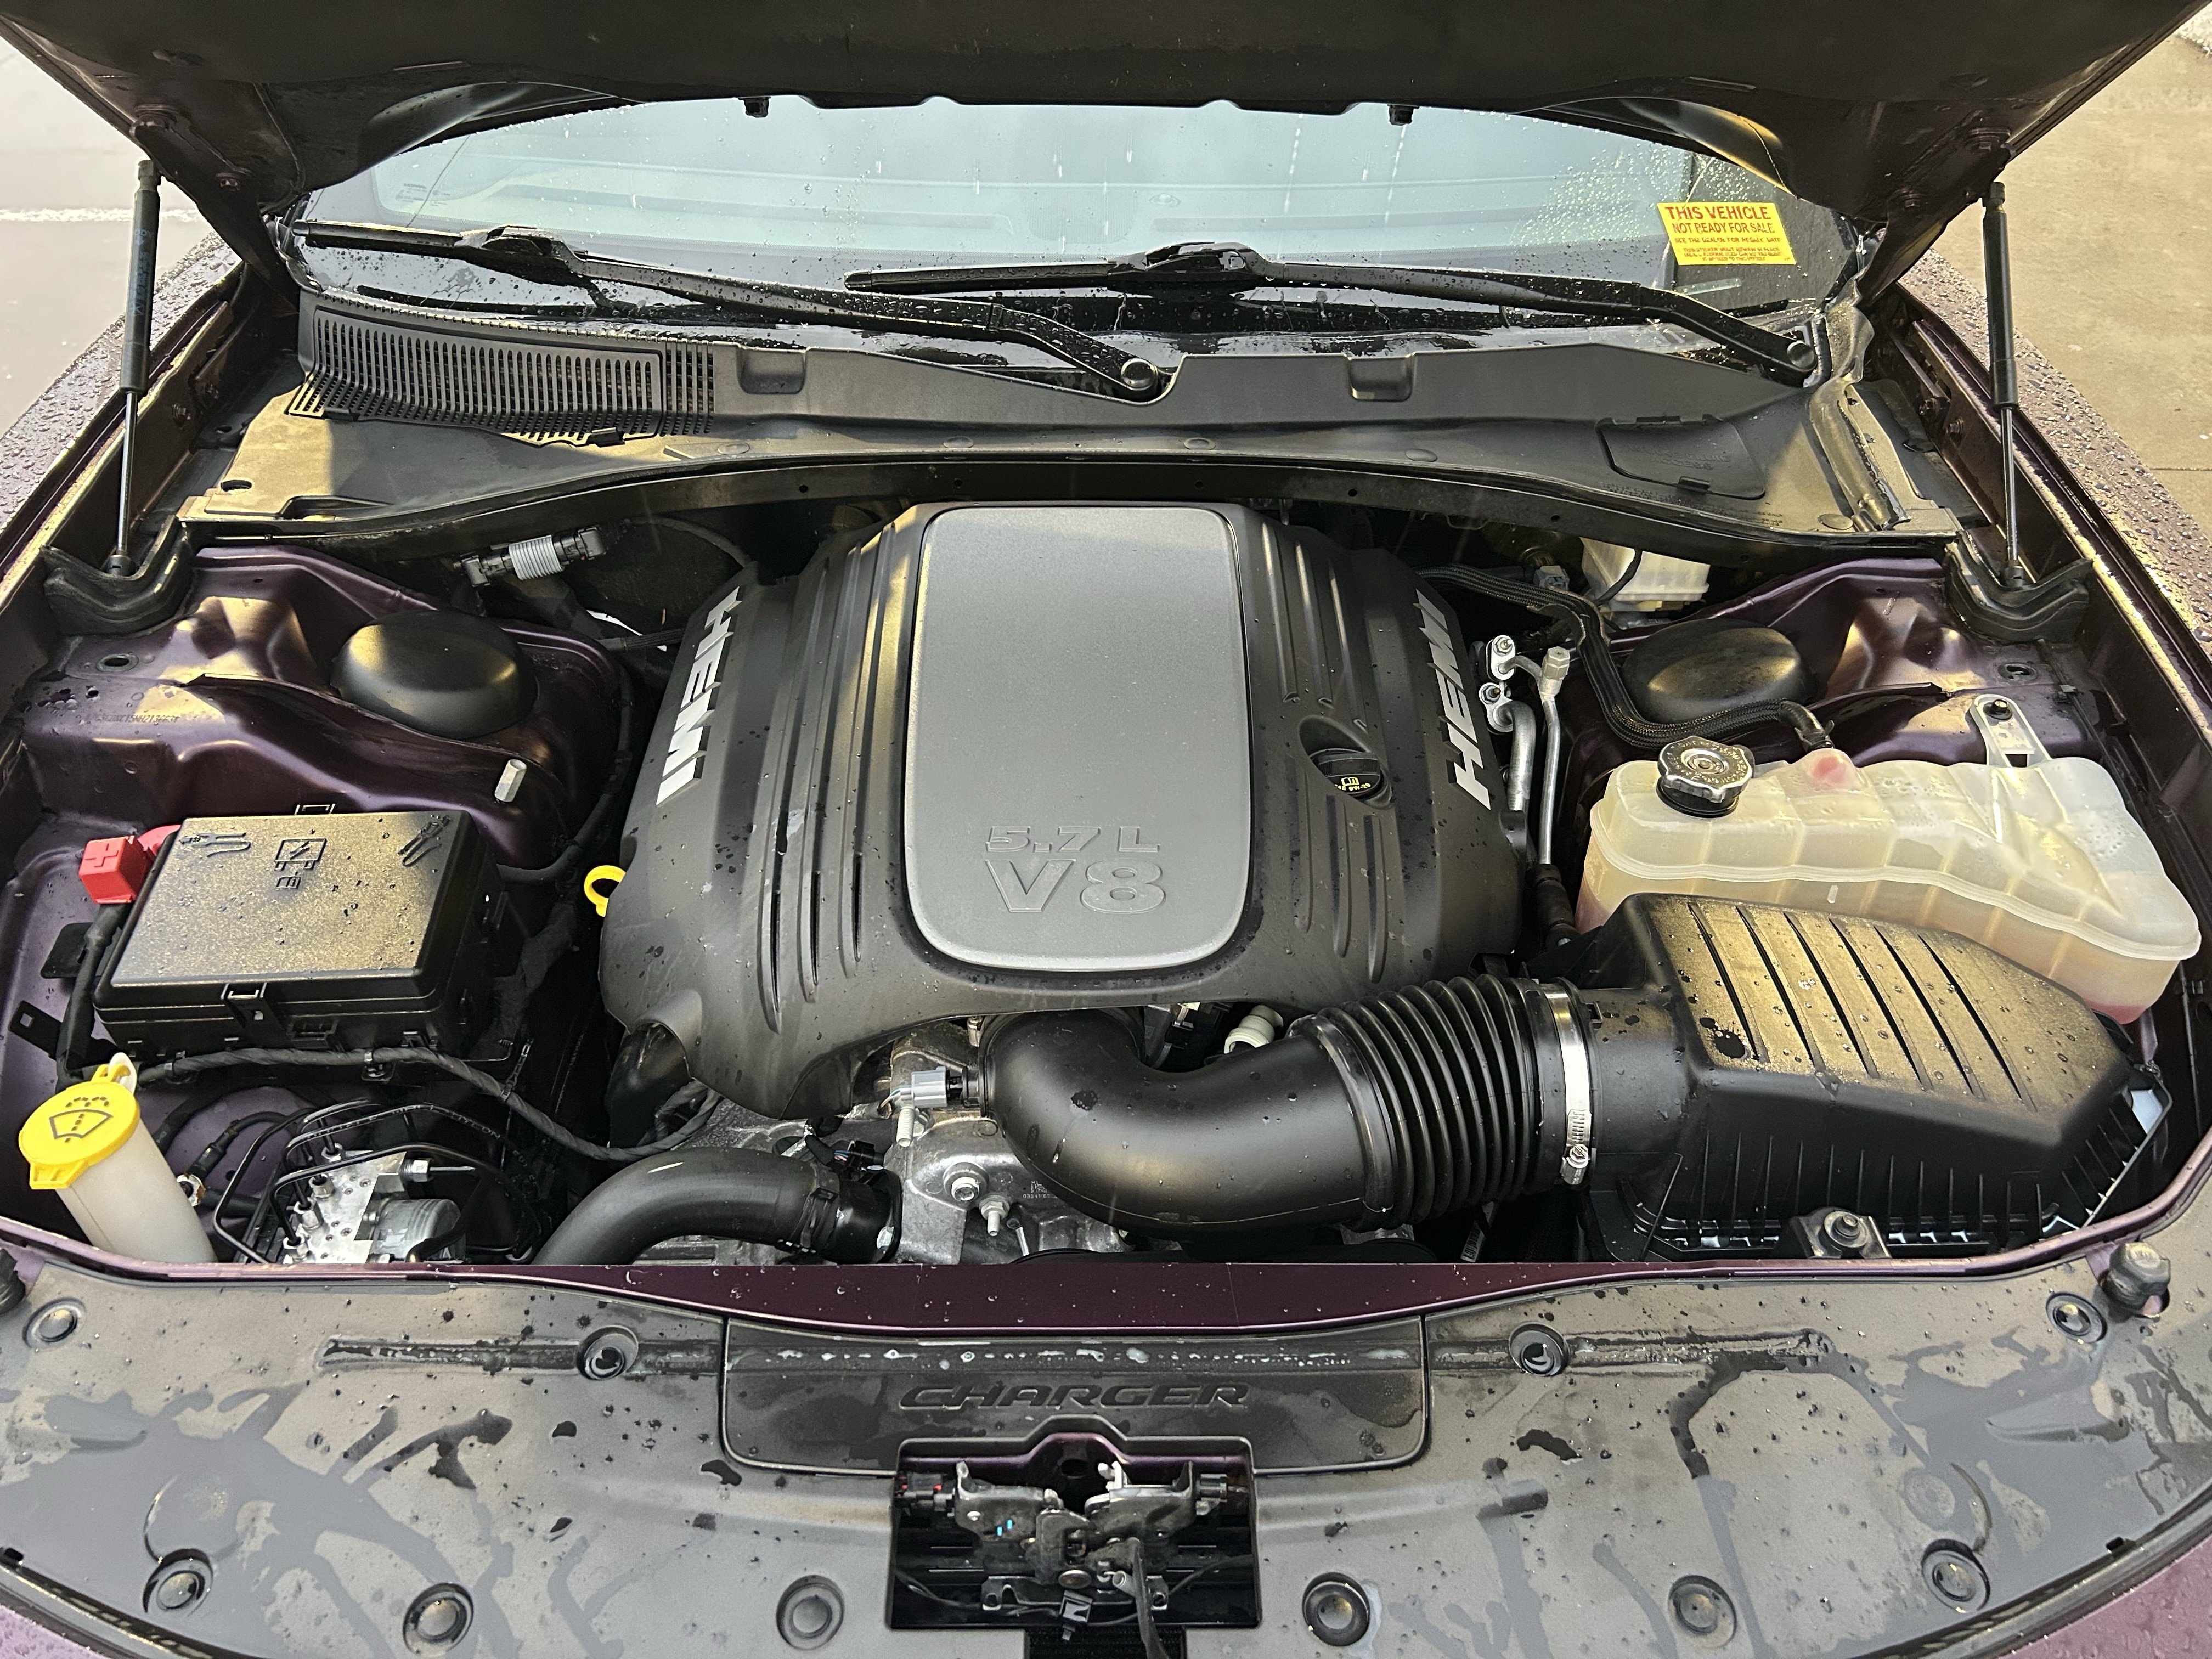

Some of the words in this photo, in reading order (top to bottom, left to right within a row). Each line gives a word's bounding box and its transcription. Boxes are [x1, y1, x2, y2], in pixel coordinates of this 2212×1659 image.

[1665, 206, 1703, 220] THIS
[1705, 206, 1771, 219] VEHICLE
[1672, 223, 1692, 233] NOT
[1695, 223, 1726, 233] READY
[1729, 223, 1750, 233] FOR
[1751, 223, 1775, 233] SALE
[656, 586, 740, 805] HEMI
[1415, 588, 1491, 810] HEMI
[985, 857, 1166, 915] V8
[899, 1384, 1249, 1410] CHARGER
